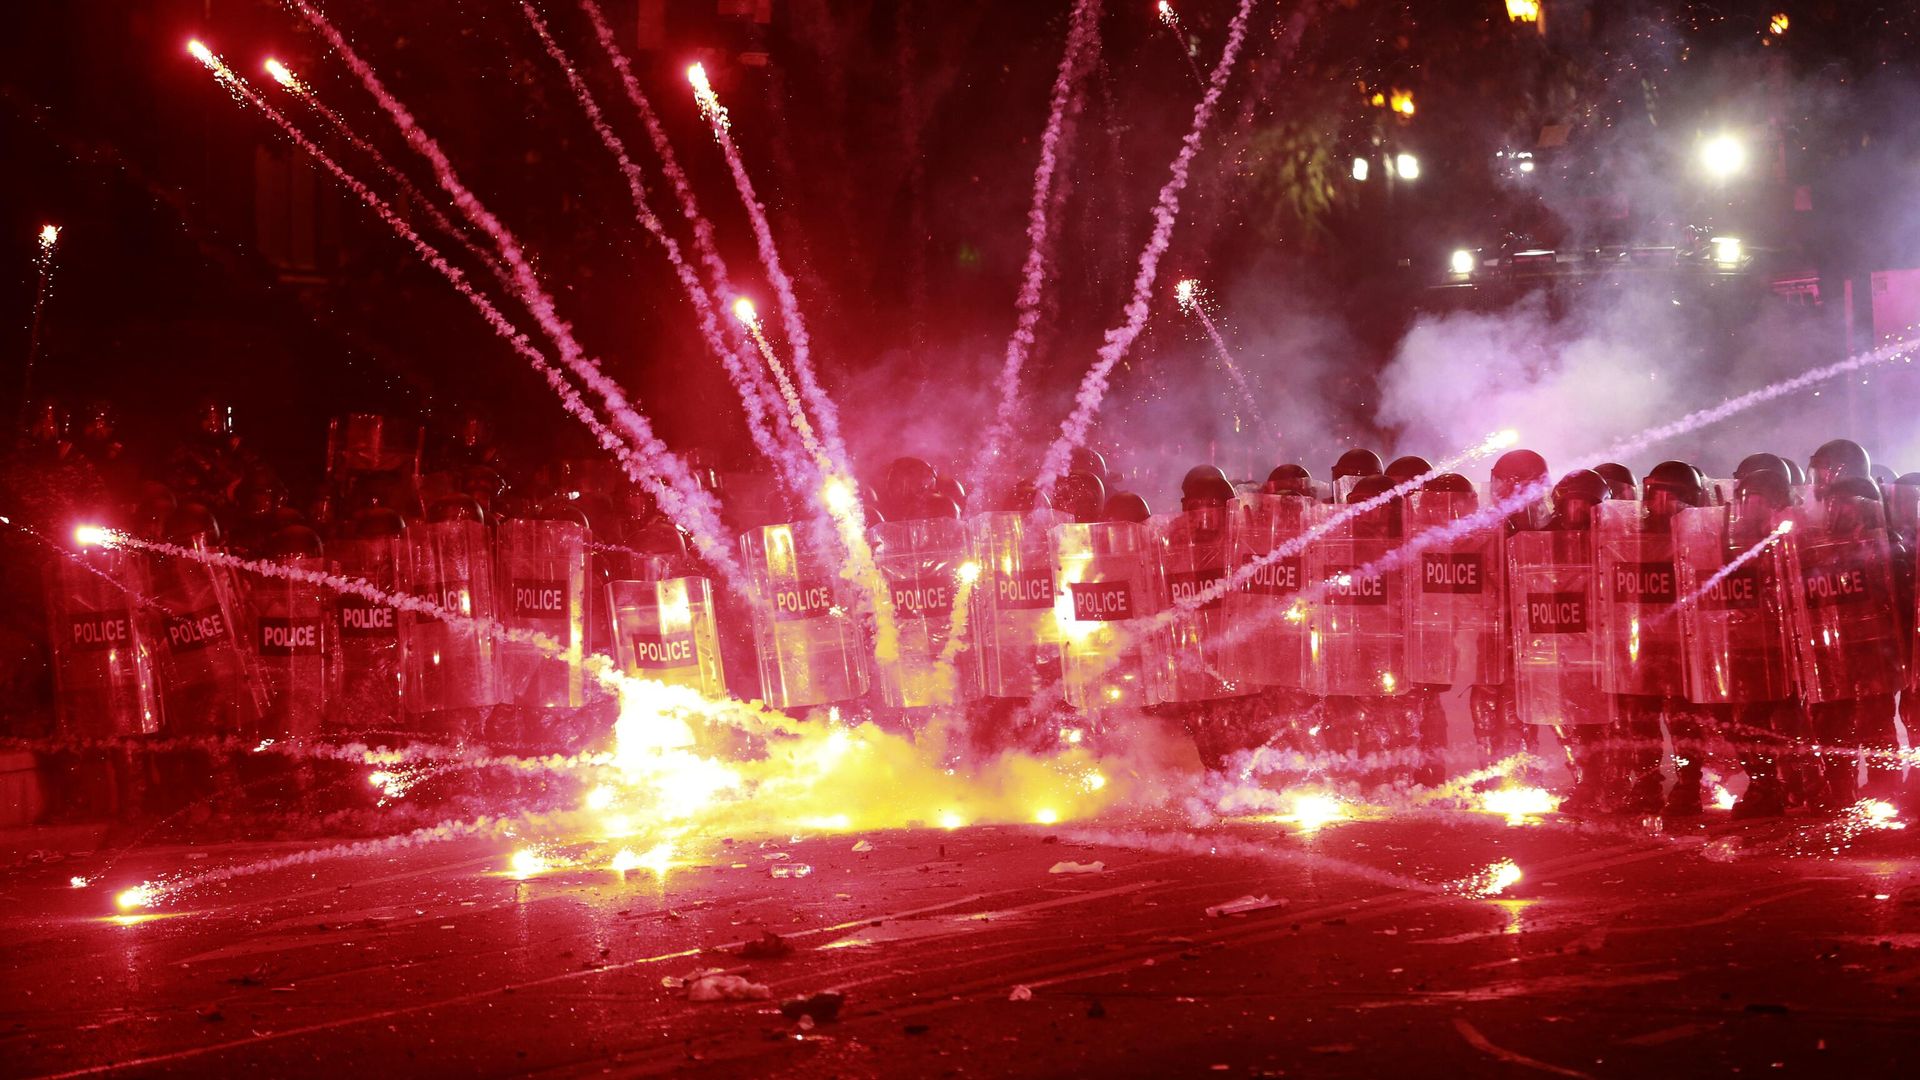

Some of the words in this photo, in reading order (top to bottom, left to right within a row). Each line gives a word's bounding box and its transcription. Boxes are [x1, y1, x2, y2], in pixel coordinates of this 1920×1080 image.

[1245, 565, 1296, 587] OLICE
[1426, 562, 1476, 584] POLICE
[1617, 572, 1670, 594] POLICE
[1808, 570, 1864, 598] POLICE
[516, 588, 562, 610] POLICE
[777, 586, 830, 613] POLICE
[896, 586, 947, 611] POLICE
[1000, 578, 1049, 601] POLICE
[1171, 579, 1224, 604] POLI
[1076, 590, 1127, 613] POLICE
[343, 608, 393, 628] POLICE
[1531, 602, 1580, 625] POLICE
[73, 619, 126, 643] POLICE
[169, 614, 224, 646] POLICE
[264, 625, 315, 647] POLICE
[638, 640, 691, 662] POLICE
